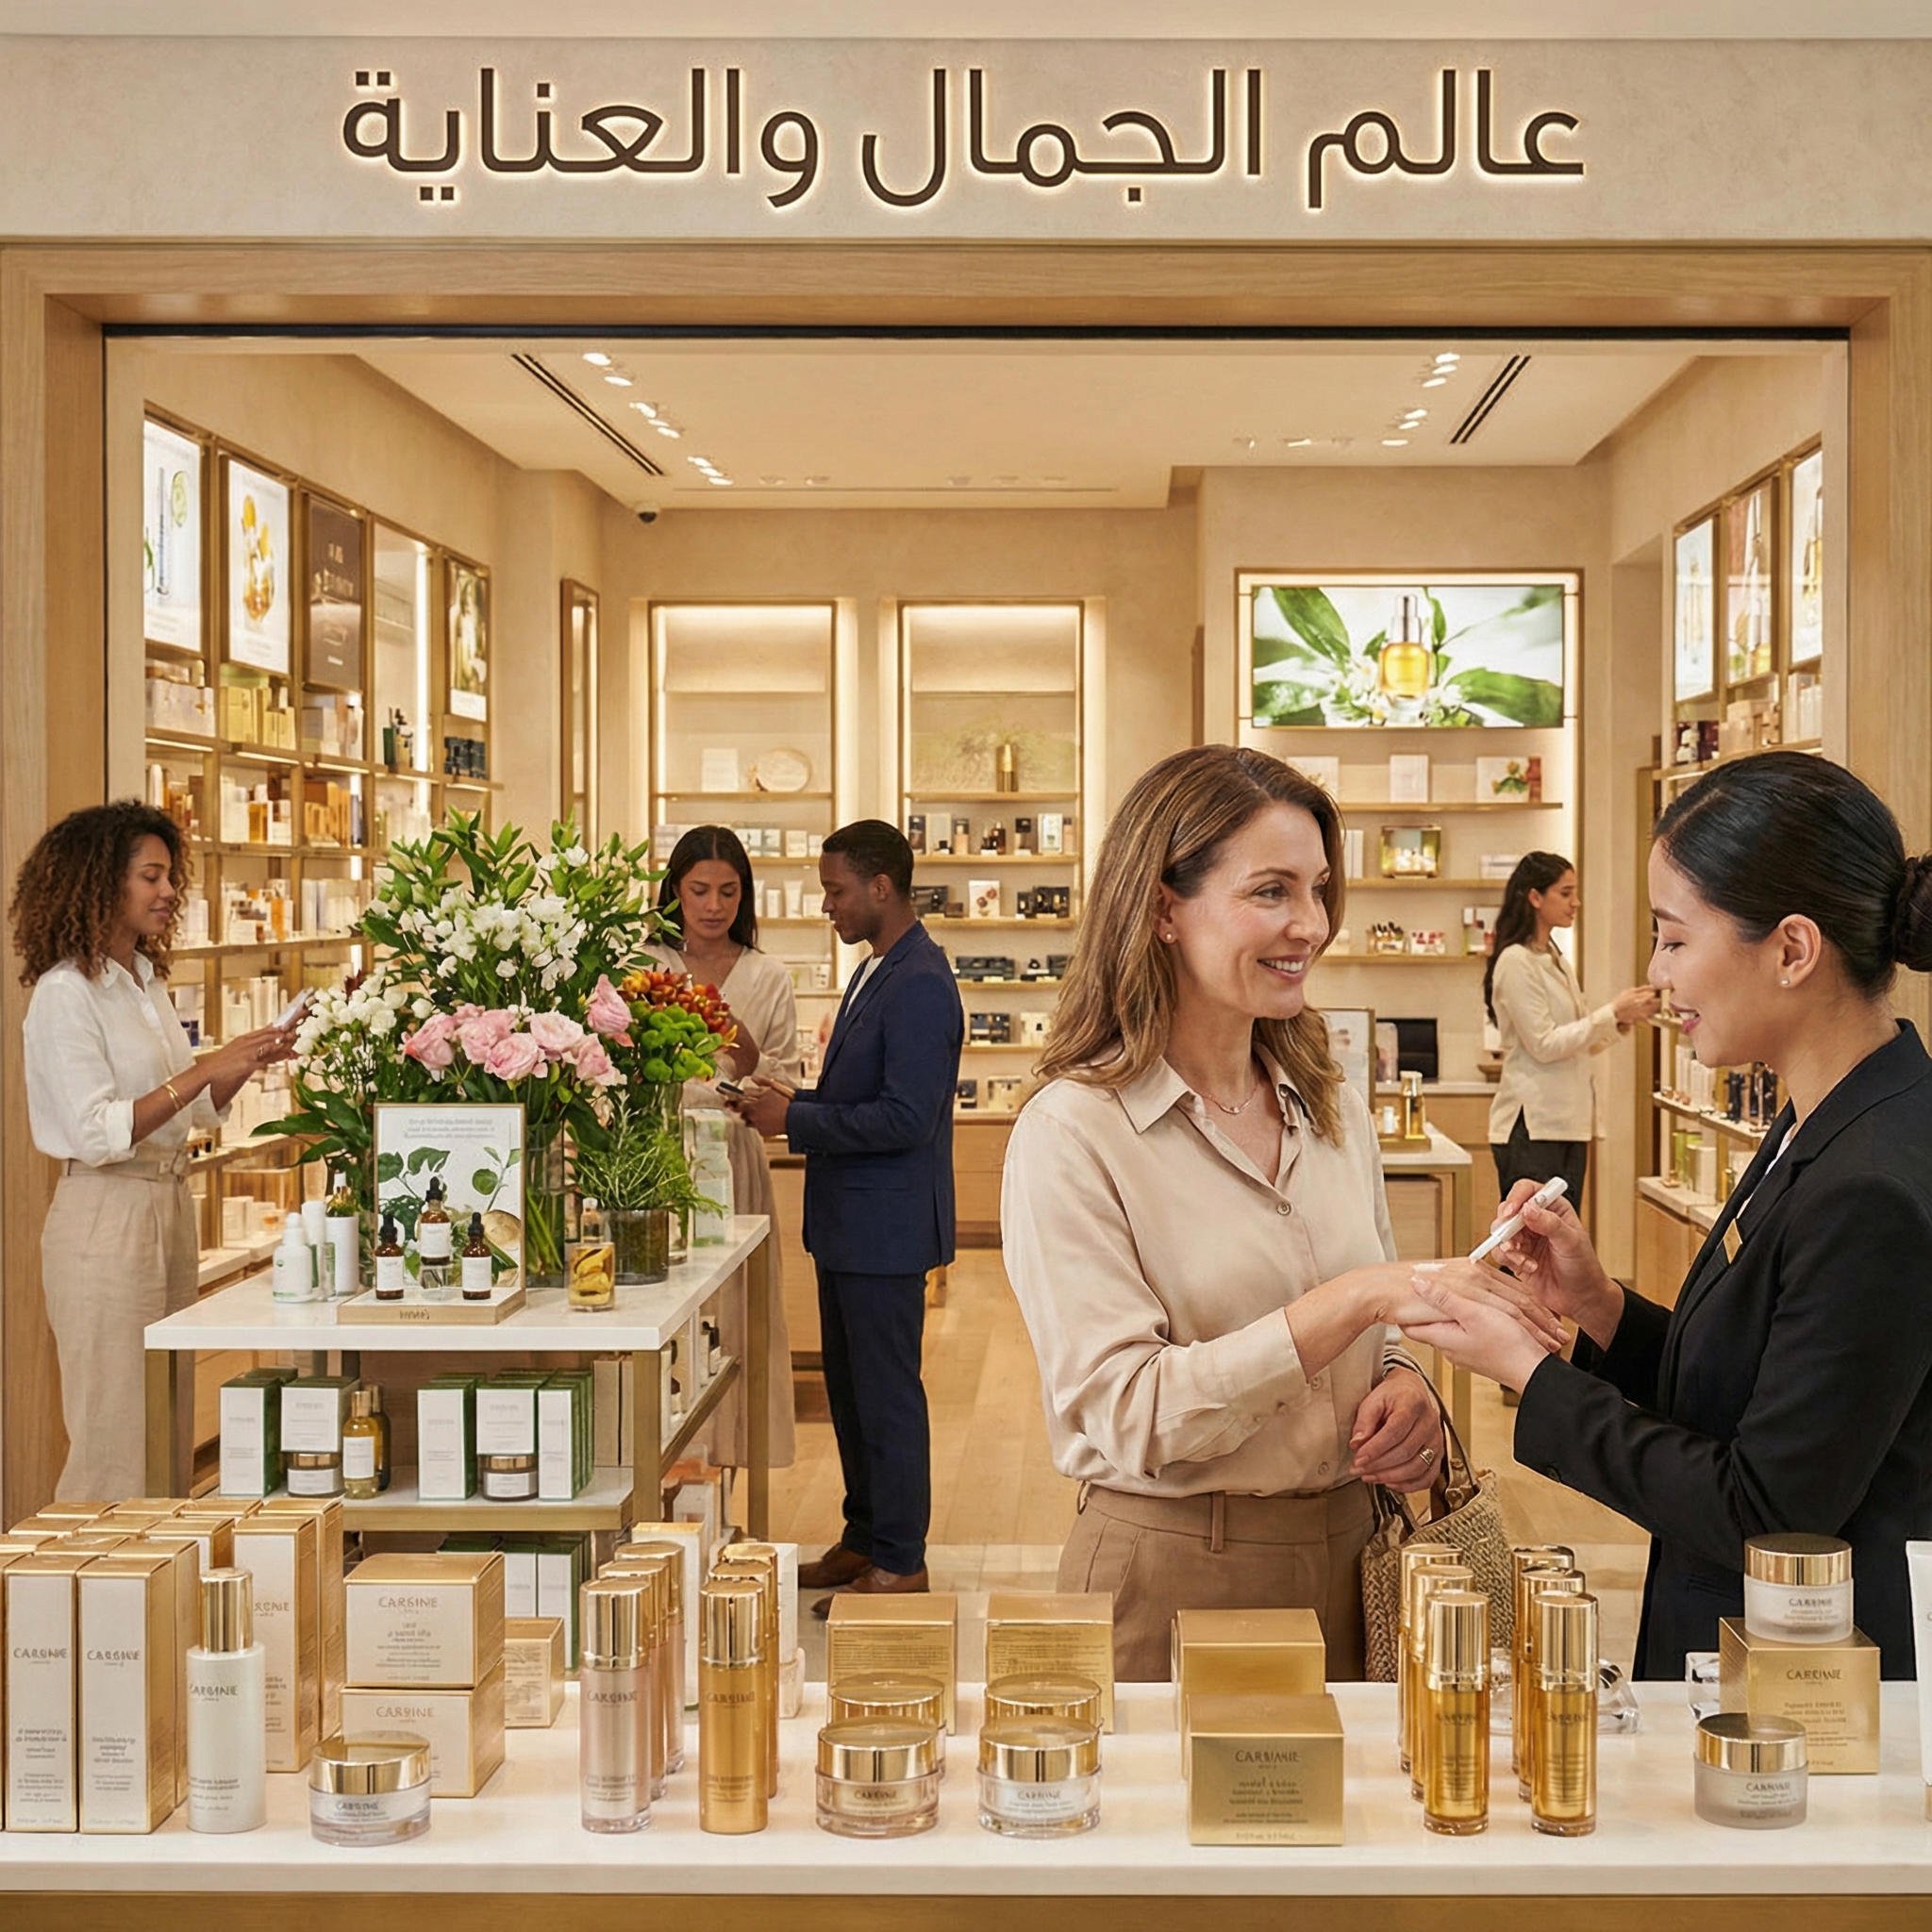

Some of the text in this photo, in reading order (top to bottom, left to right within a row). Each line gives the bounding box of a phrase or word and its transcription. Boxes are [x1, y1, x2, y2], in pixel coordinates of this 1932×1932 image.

[342, 68, 1584, 208] عالم الجمال والعناية
